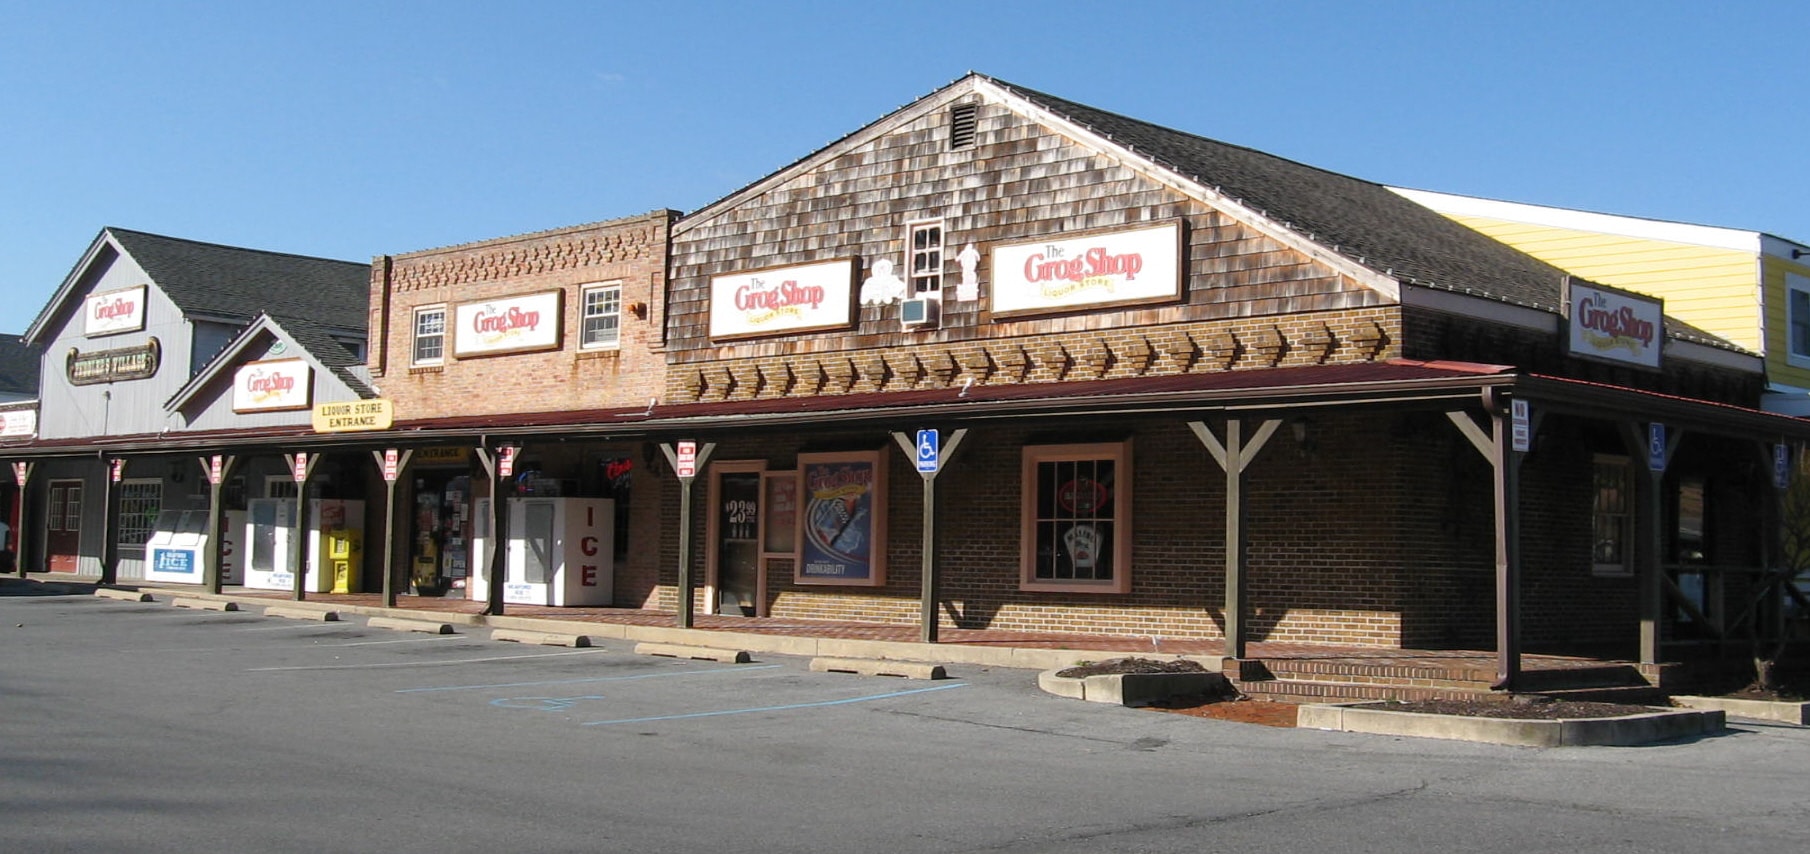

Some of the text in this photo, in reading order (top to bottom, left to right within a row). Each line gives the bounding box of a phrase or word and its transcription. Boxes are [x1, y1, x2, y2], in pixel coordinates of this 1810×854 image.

[1045, 244, 1064, 259] The
[1024, 247, 1143, 283] Grog Shop
[751, 278, 765, 289] The
[1043, 278, 1109, 297] LIQUOR STORE
[735, 280, 825, 311] Grog Shop
[1593, 291, 1607, 308] The
[114, 298, 135, 318] Shop
[474, 307, 540, 334] Grog Shop
[1579, 297, 1621, 338] Grog
[1620, 306, 1654, 348] Shop
[248, 371, 295, 394] Grog Shop
[322, 403, 383, 417] LIQUOR STORE
[329, 416, 377, 428] ENTRANCE
